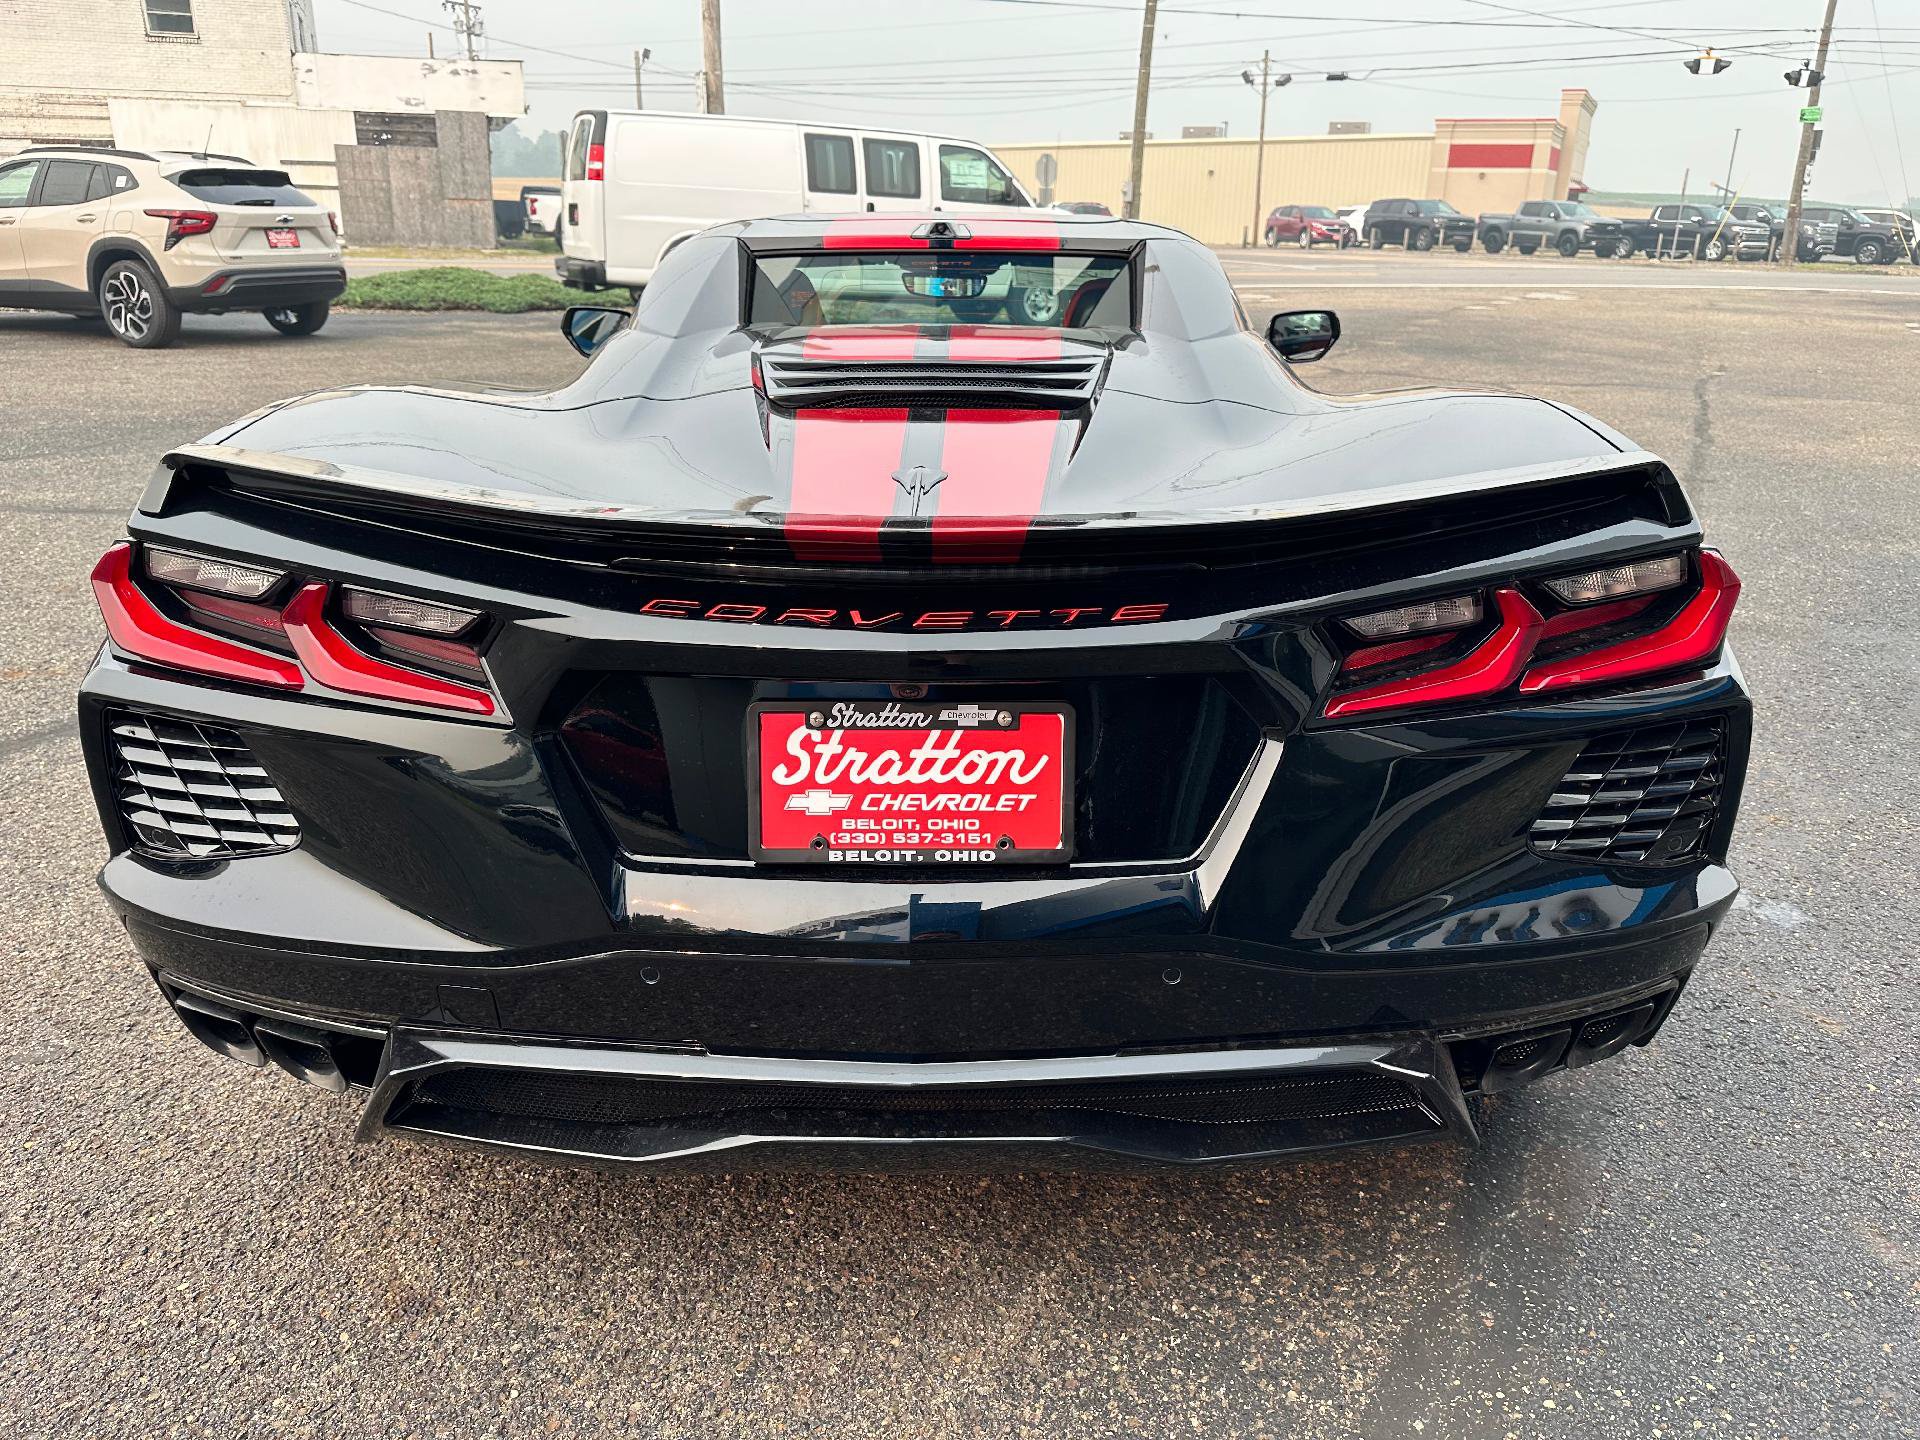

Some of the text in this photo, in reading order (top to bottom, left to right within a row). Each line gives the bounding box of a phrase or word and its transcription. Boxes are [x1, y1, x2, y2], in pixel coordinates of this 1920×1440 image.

[640, 599, 1169, 629] CORVETTE
[826, 702, 989, 728] Stratton Chevrolet
[771, 725, 1049, 786] Stratton
[860, 794, 1037, 812] CHEVROLET
[841, 818, 980, 831] BELOIT, OHIO
[830, 832, 992, 844] (330) 537-3151
[828, 850, 996, 862] BELOIT, OHIO
